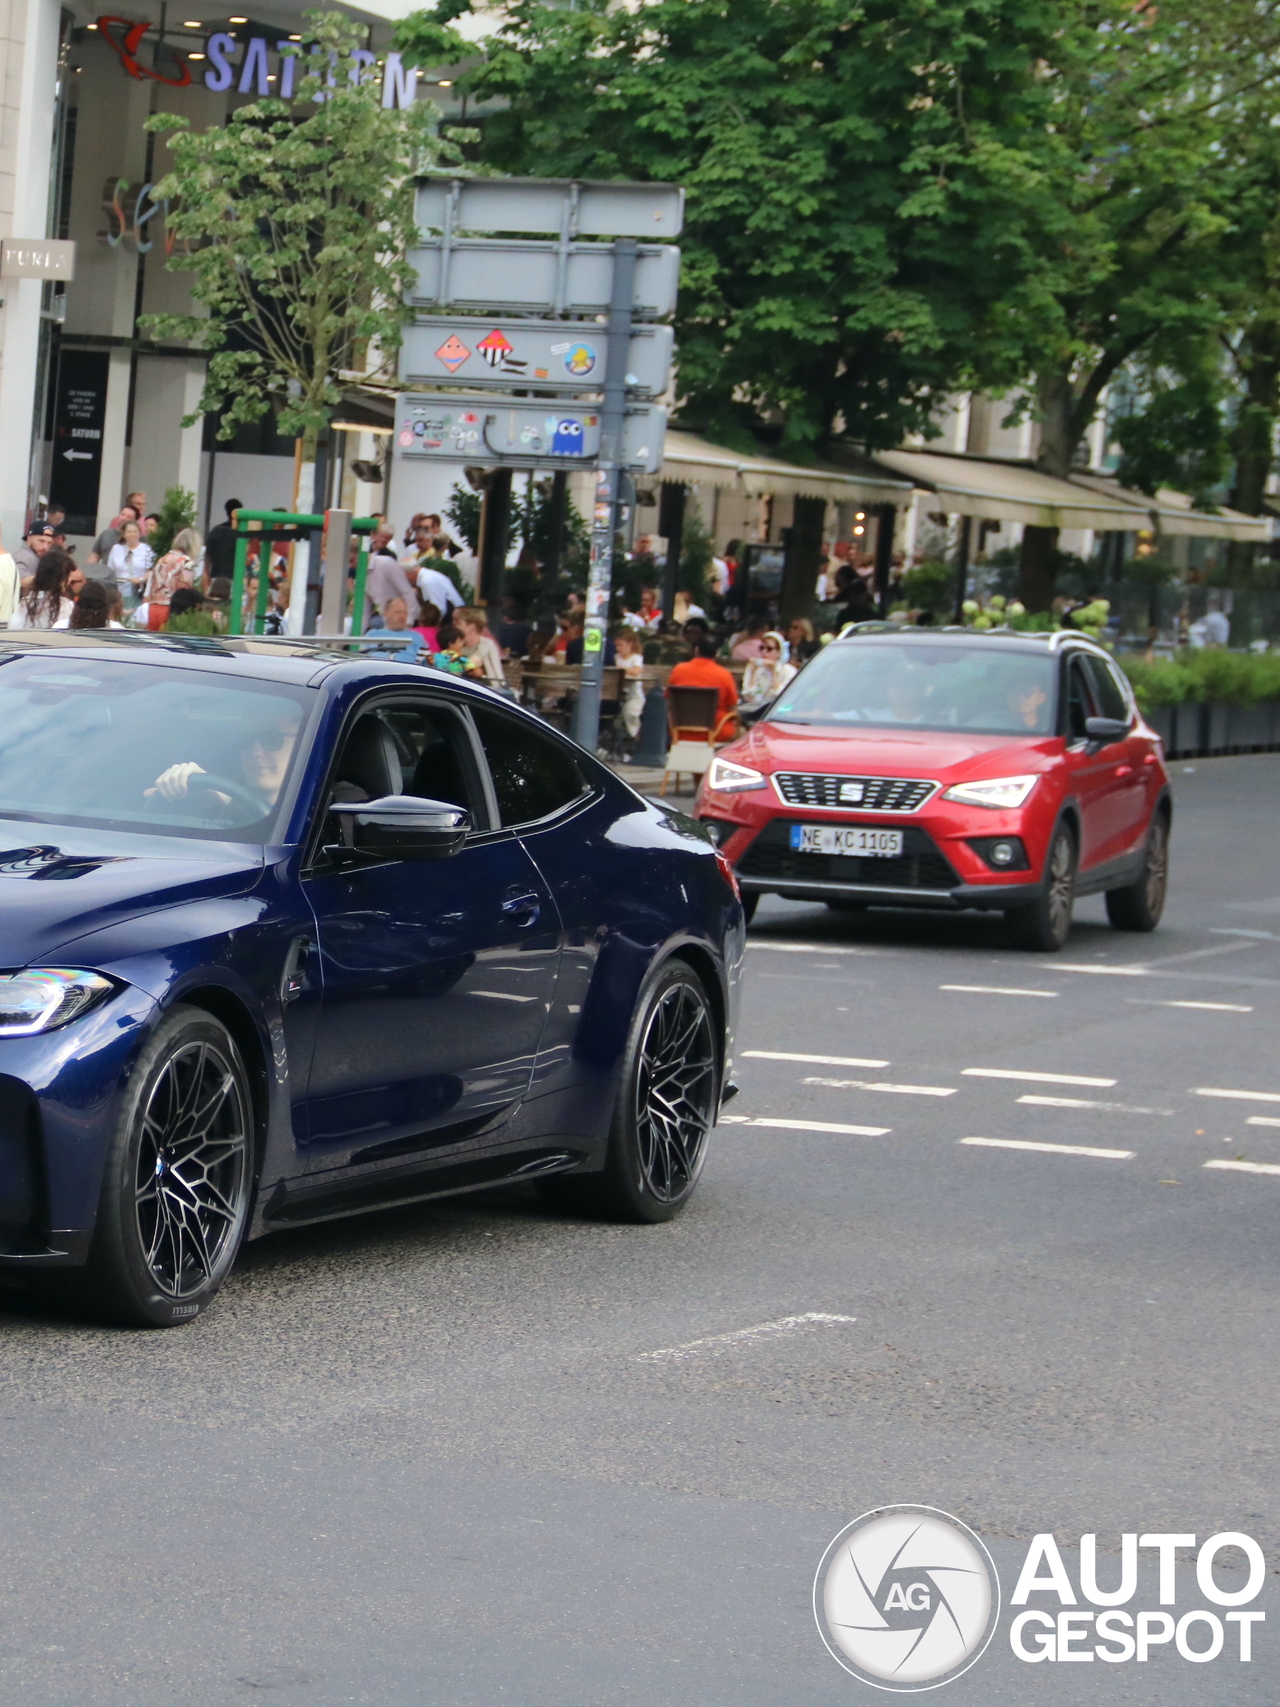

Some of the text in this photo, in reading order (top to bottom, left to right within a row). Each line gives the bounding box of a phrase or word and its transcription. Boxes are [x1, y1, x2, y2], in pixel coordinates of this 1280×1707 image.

[6, 250, 68, 269] FURLA
[71, 428, 101, 439] SATURN
[803, 829, 898, 850] NE KC 1105
